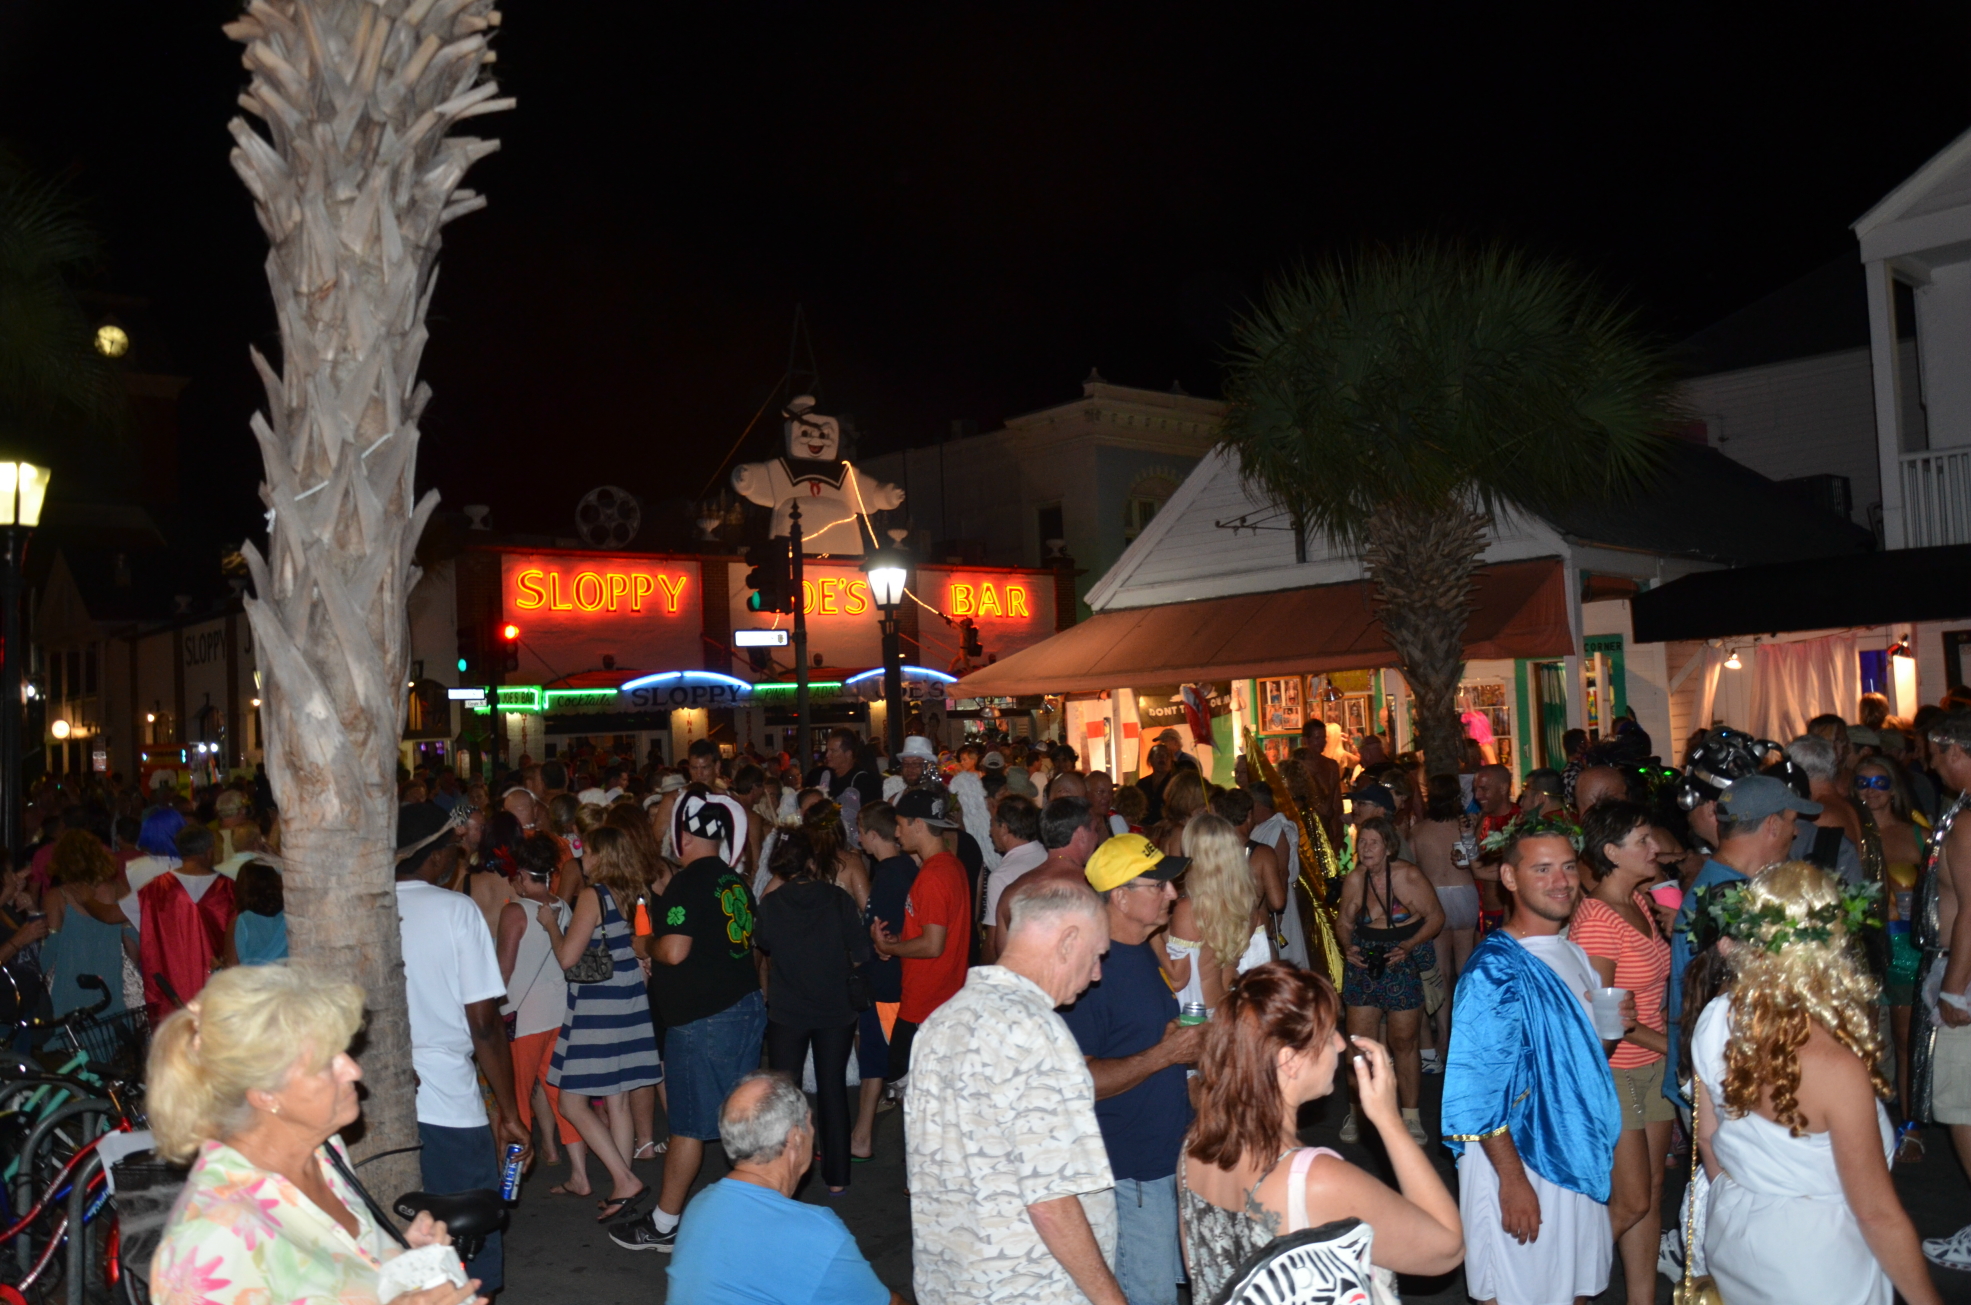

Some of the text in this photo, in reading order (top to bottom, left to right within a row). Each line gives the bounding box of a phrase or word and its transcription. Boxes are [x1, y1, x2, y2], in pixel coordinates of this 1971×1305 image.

[514, 569, 1030, 616] SLOPPY OE'S BAR
[185, 628, 227, 667] SLOPPY
[1583, 641, 1622, 652] CORNER
[557, 693, 612, 708] Cocktails
[631, 685, 743, 707] SLOPPY
[503, 1156, 518, 1190] ULTR
